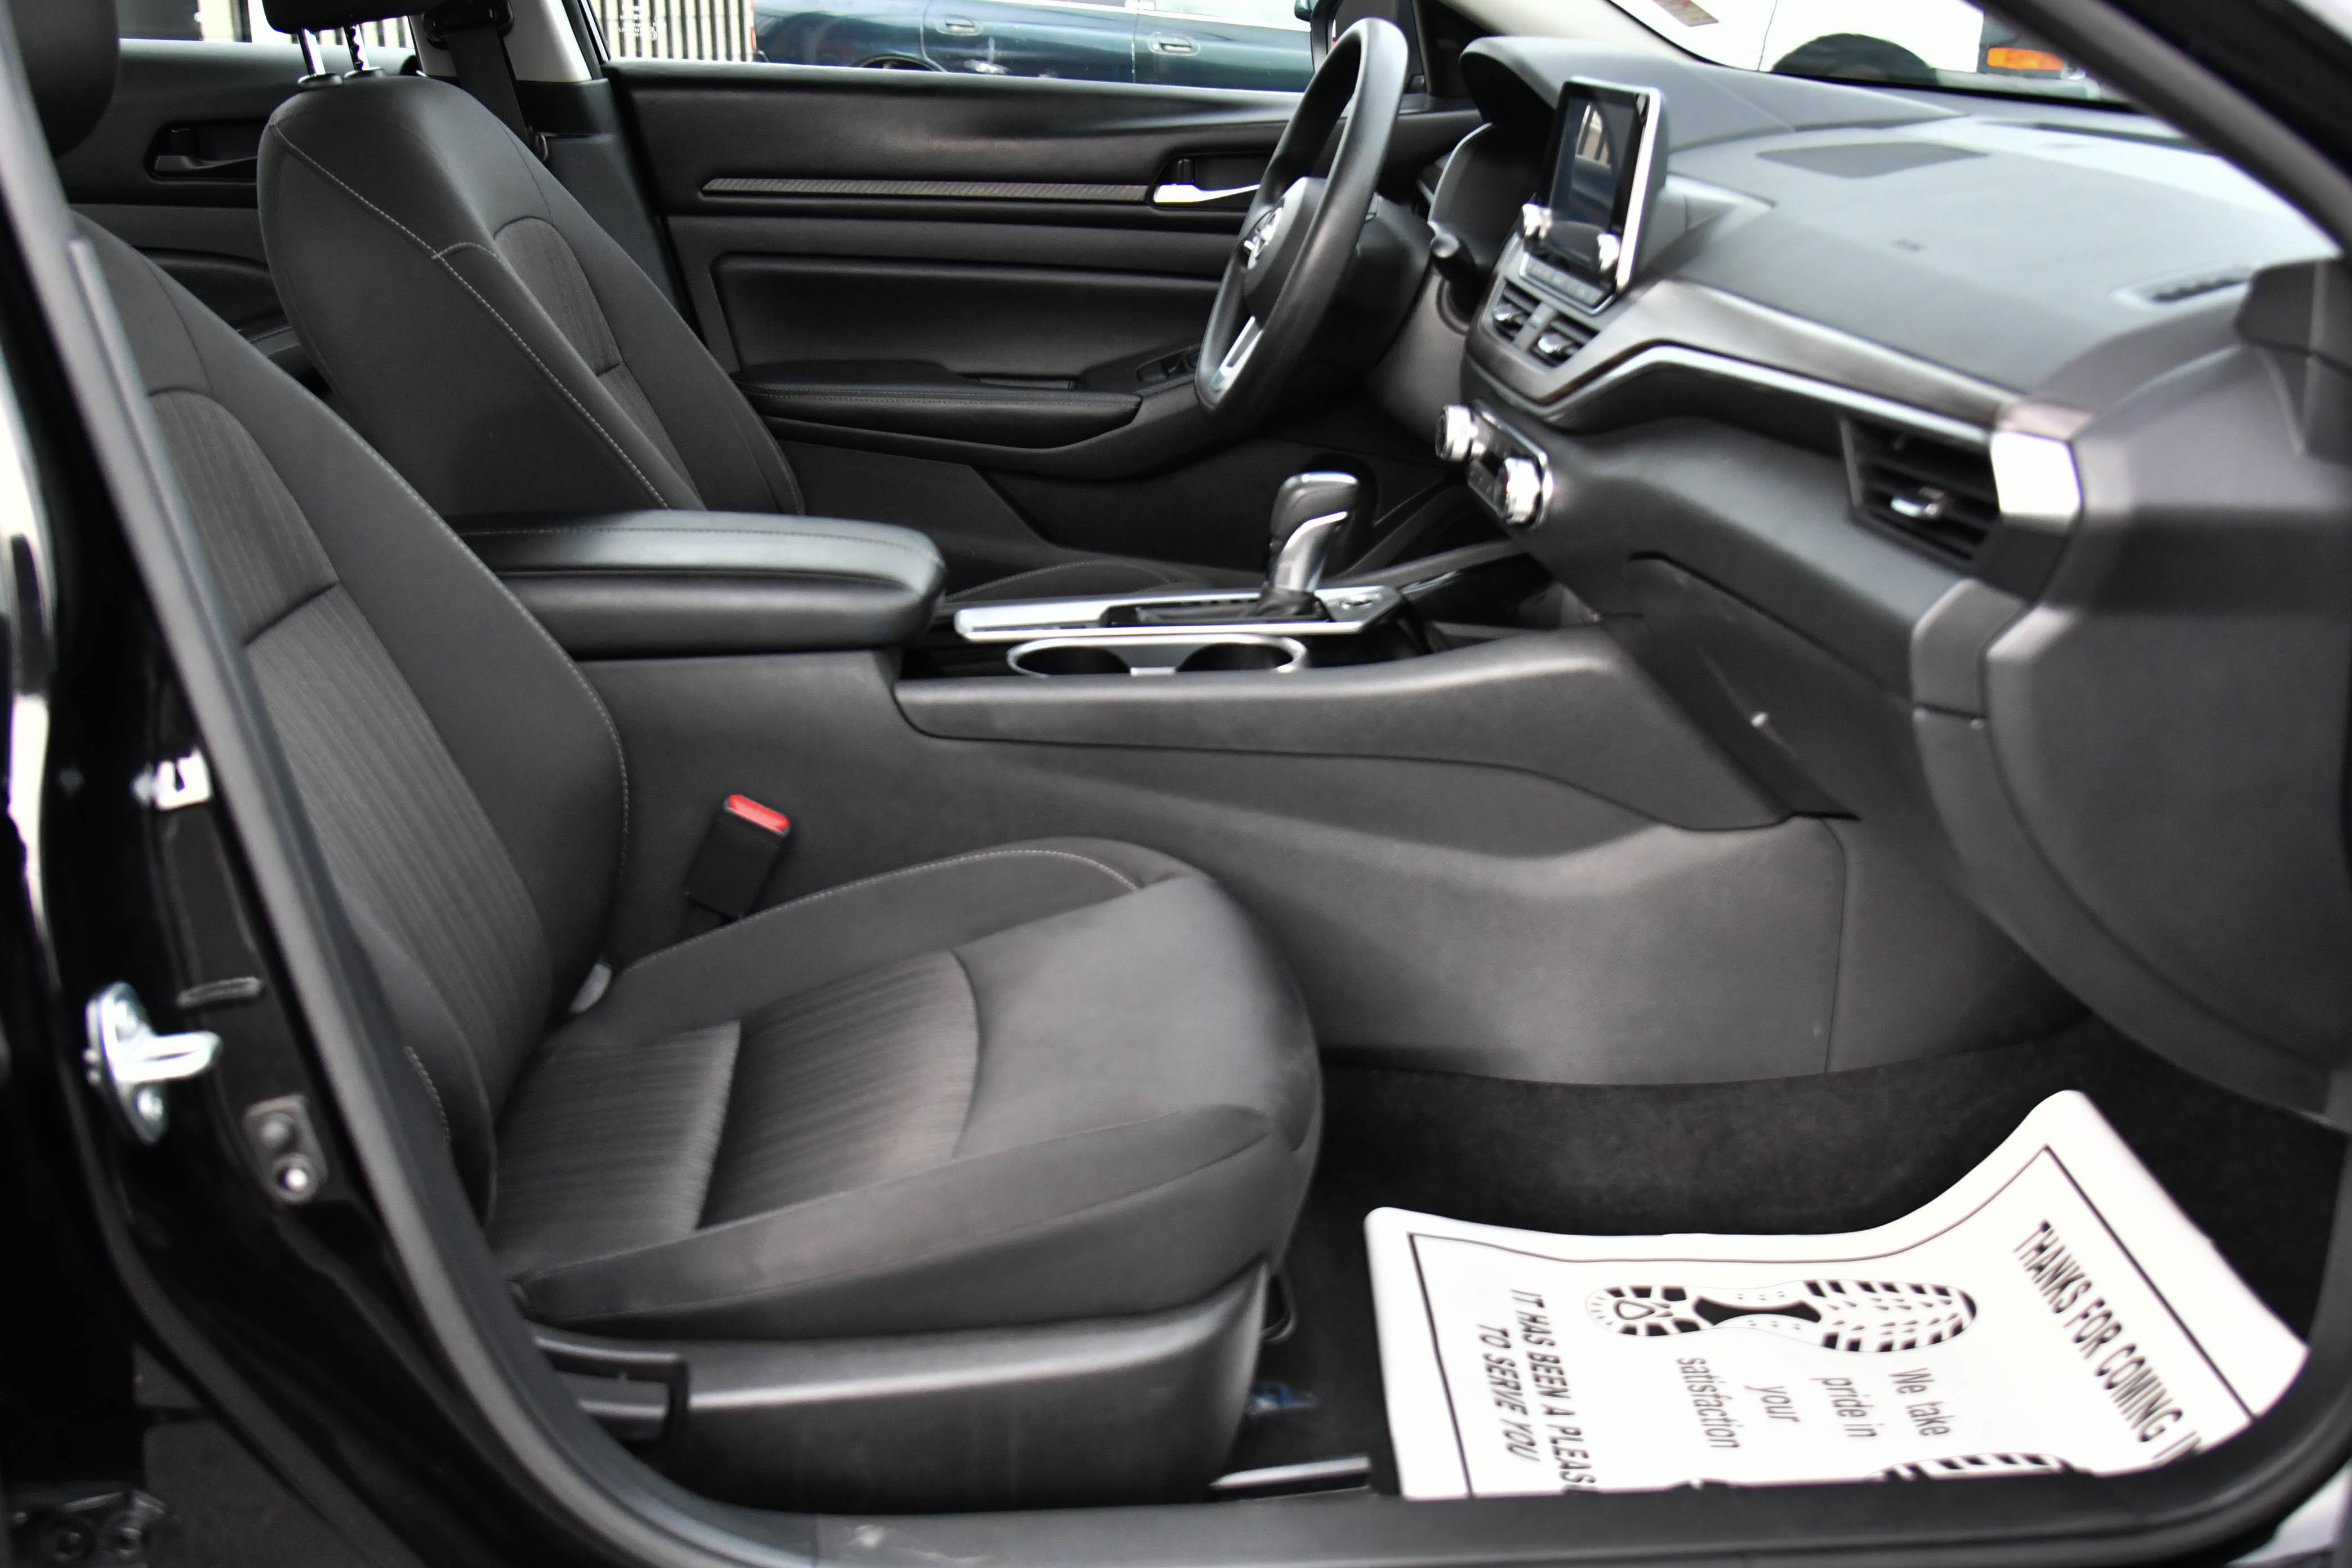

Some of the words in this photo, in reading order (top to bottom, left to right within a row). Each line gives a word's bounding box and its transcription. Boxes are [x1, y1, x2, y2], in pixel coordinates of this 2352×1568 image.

[1510, 1289, 1545, 1309] IT
[1476, 1324, 1512, 1349] TO
[1516, 1310, 1556, 1347] HAS
[2013, 1218, 2092, 1314] THANKS
[2063, 1297, 2123, 1360] FOR
[2093, 1343, 2184, 1442] COMING
[1482, 1352, 1529, 1416] SERVE
[1526, 1351, 1571, 1400] BEEN
[1888, 1367, 1935, 1395] We
[1540, 1404, 1576, 1416] A
[1676, 1357, 1744, 1449] satisfaction
[1743, 1385, 1801, 1422] your
[1809, 1377, 1874, 1418] pride
[1843, 1423, 1884, 1437] in
[1905, 1401, 1955, 1437] take
[1499, 1418, 1541, 1462] YOU
